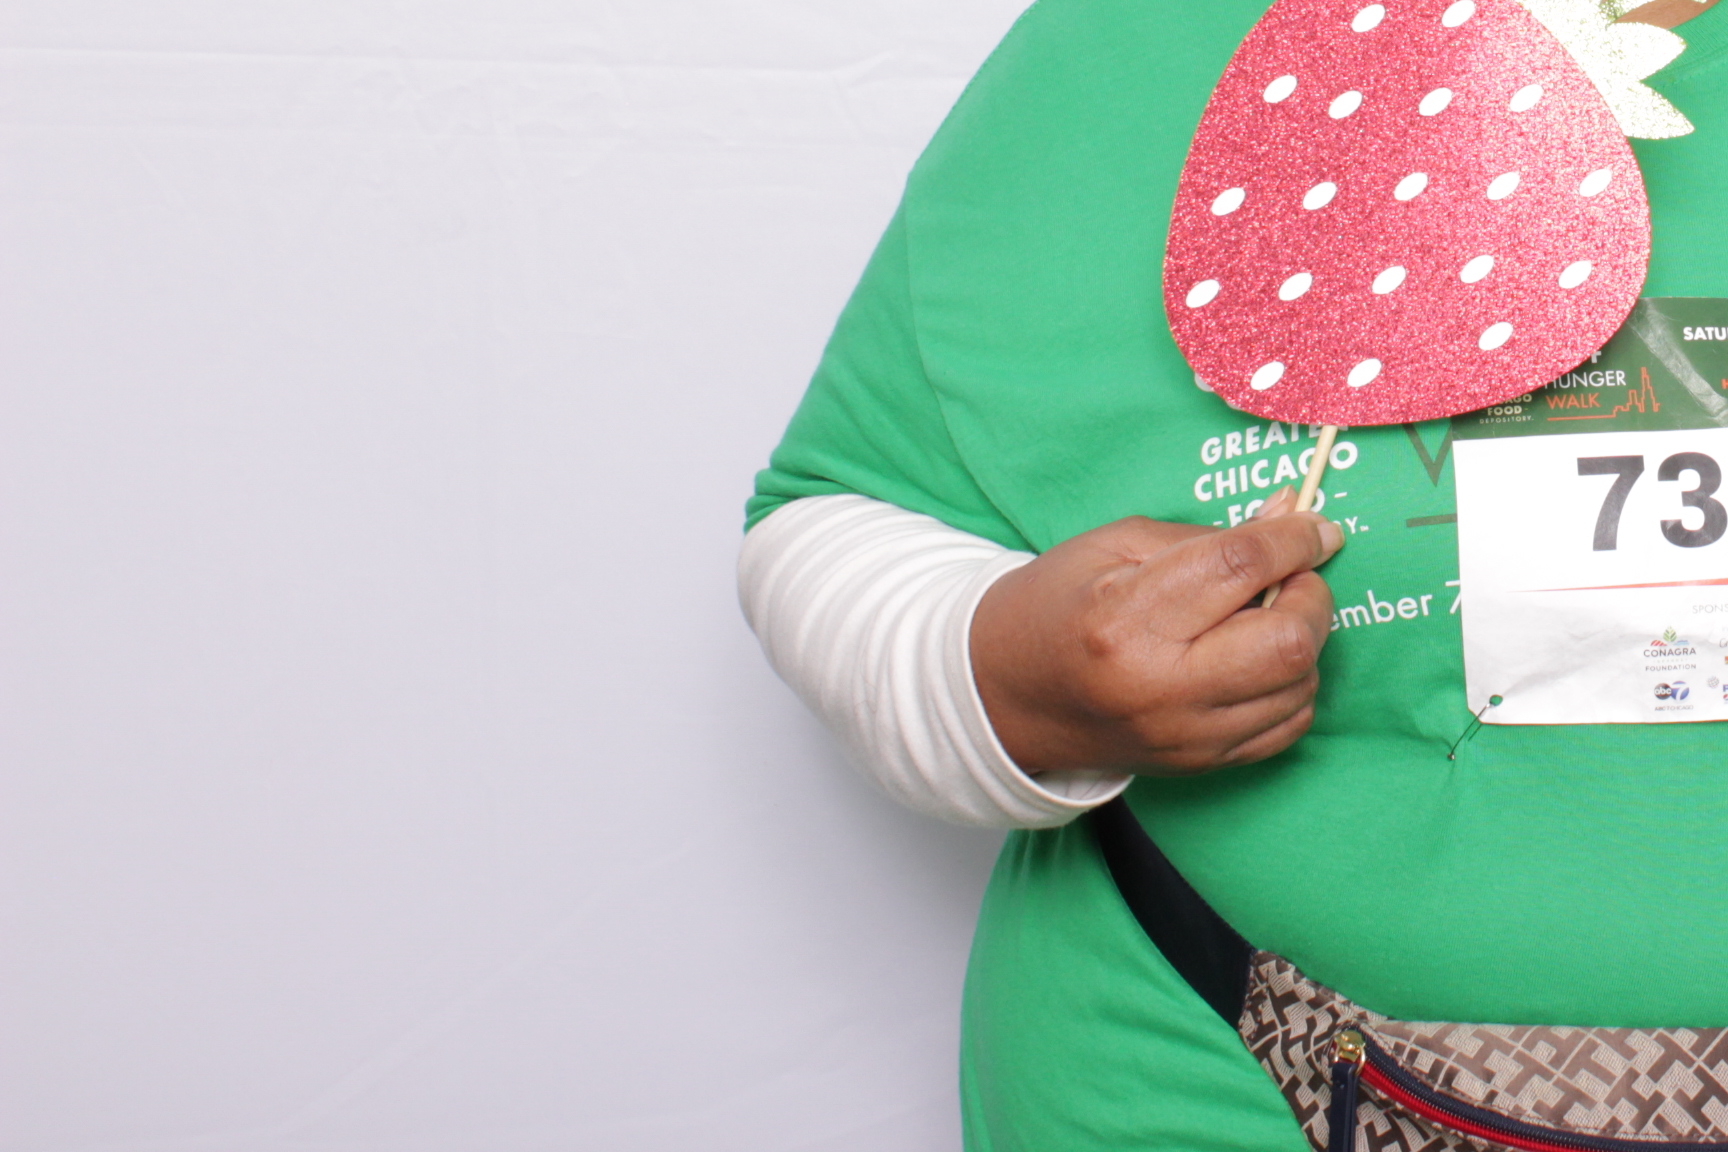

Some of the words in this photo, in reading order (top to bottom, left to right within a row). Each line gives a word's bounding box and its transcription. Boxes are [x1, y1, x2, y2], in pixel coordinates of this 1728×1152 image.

[1545, 392, 1601, 409] WALK
[1487, 405, 1522, 416] FOOD
[1201, 422, 1349, 465] GREAT
[1643, 647, 1697, 658] CONAGRA
[1645, 664, 1697, 672] FOUNDATION
[1654, 686, 1672, 695] abc
